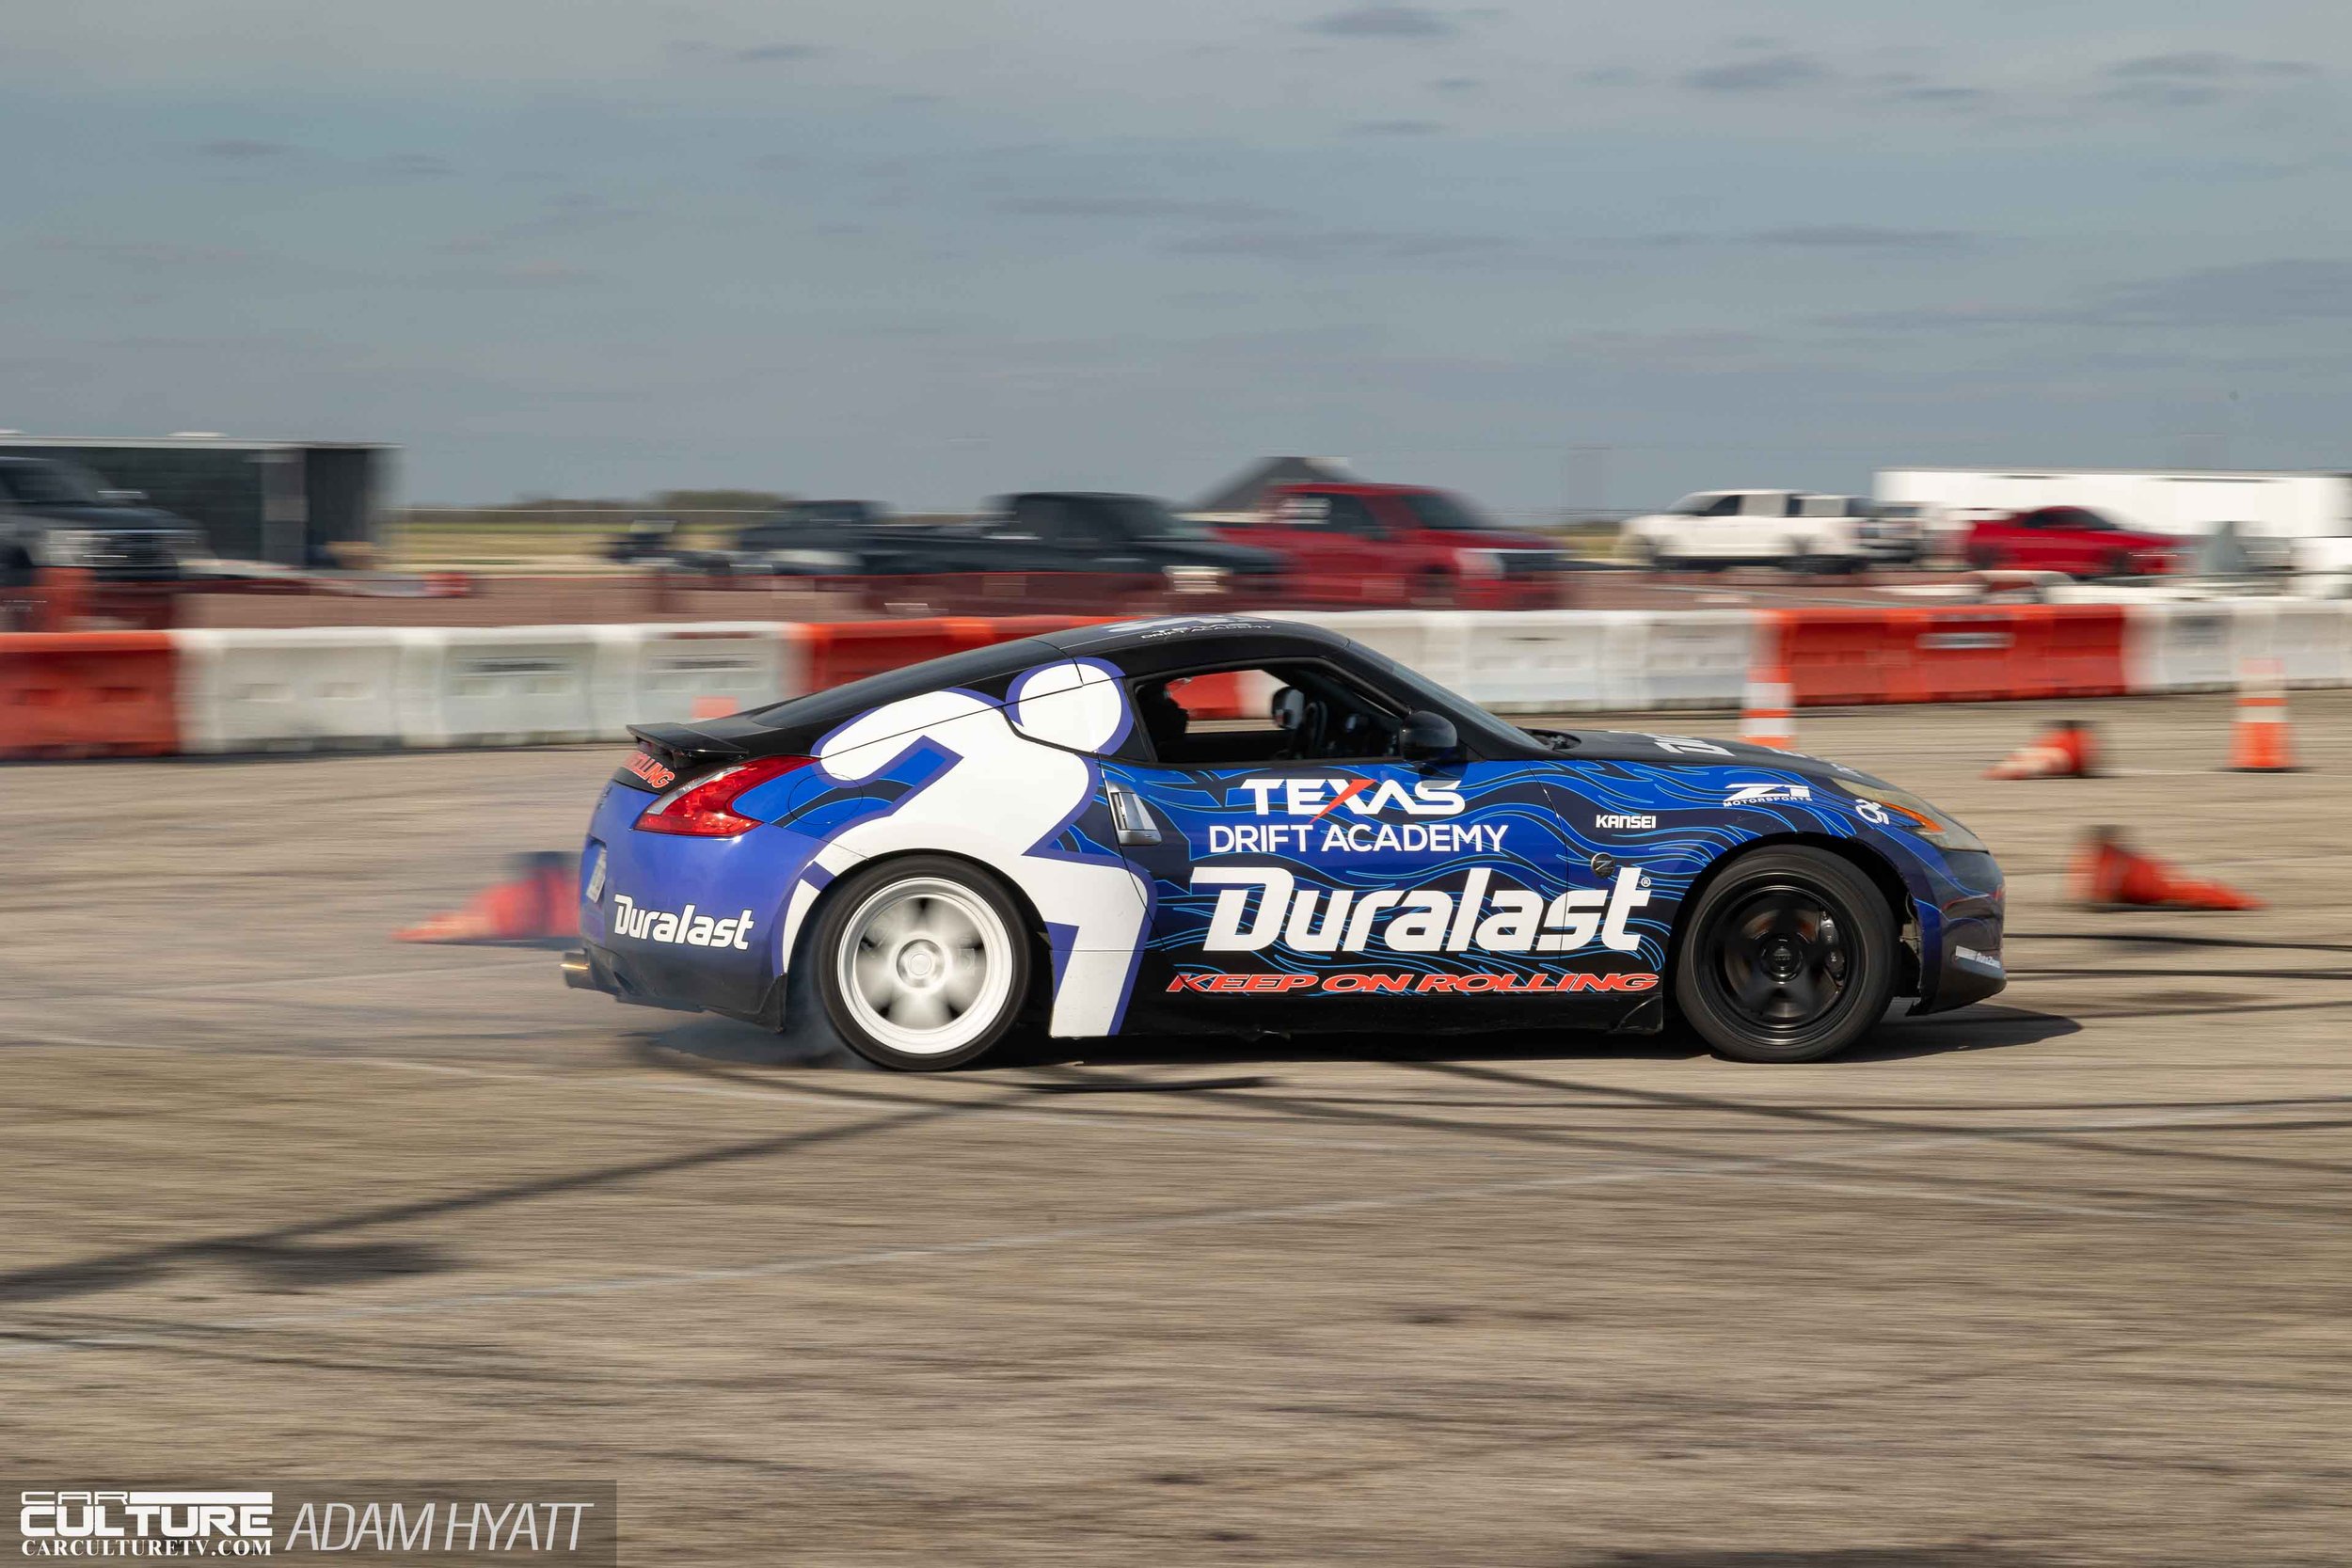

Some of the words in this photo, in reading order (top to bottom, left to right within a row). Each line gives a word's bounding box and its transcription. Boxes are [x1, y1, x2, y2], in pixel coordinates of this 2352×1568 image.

[1240, 778, 1466, 824] TEXAS
[1723, 796, 1813, 808] MOTORSPORTS
[1596, 815, 1657, 830] KANSEI
[1209, 824, 1313, 853] DRIFT
[1321, 824, 1509, 853] ACADEMY
[613, 894, 755, 950] Duralast
[1166, 973, 1320, 993] KEEP
[1321, 973, 1420, 993] ON
[1418, 973, 1660, 992] ROLLING
